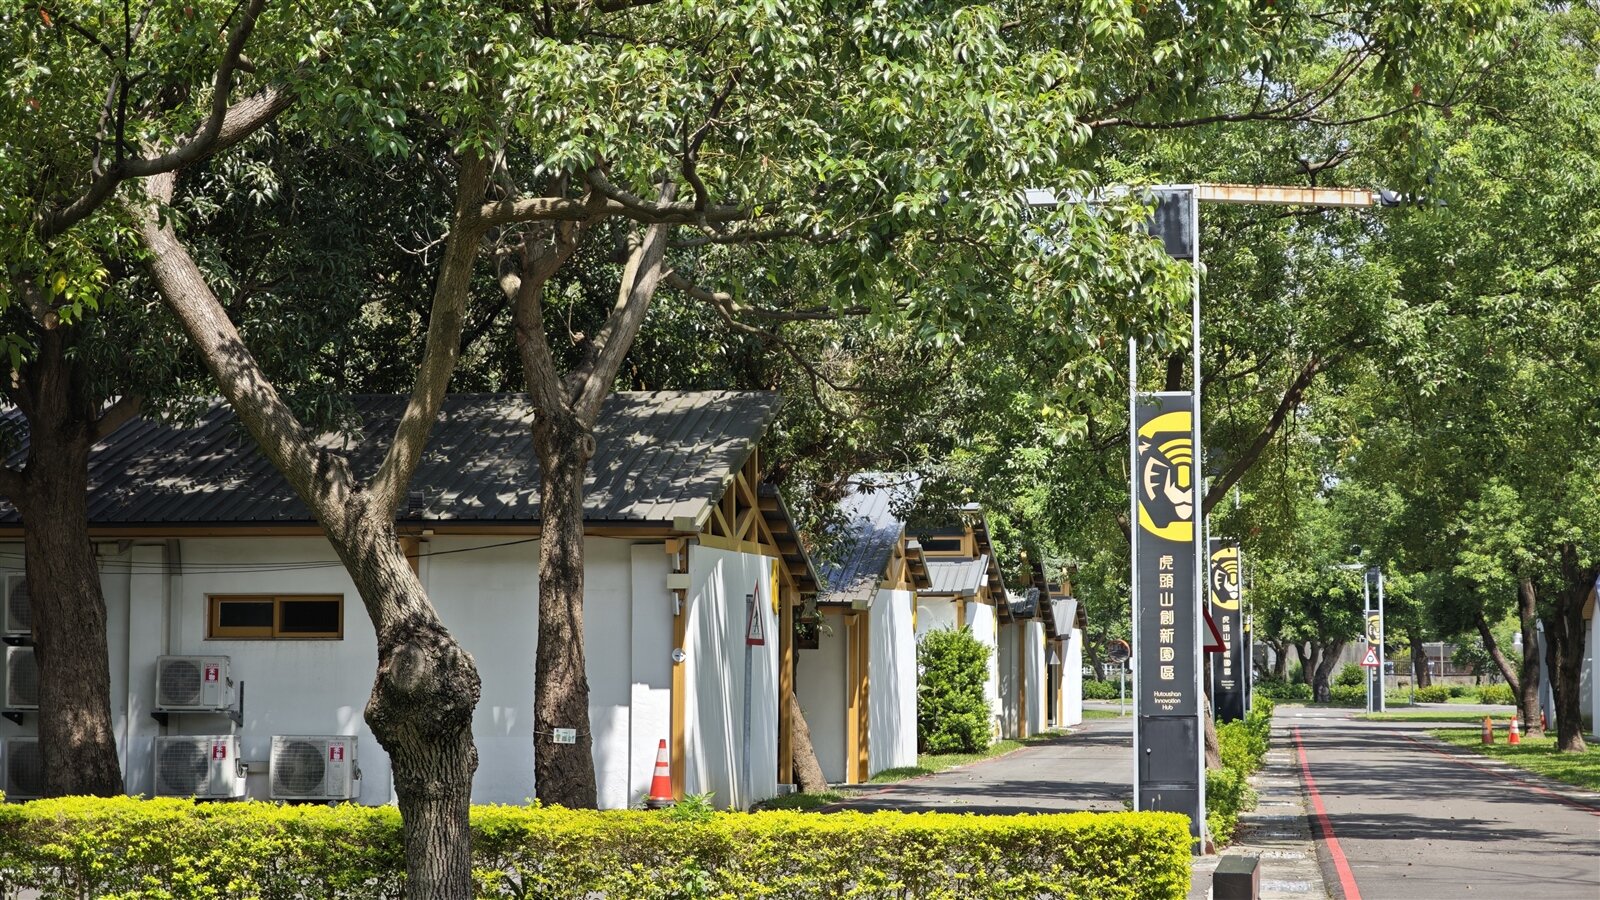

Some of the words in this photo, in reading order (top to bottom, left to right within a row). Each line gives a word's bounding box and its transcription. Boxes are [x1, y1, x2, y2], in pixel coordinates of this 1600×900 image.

[1159, 554, 1175, 681] 虎頭山創新園區
